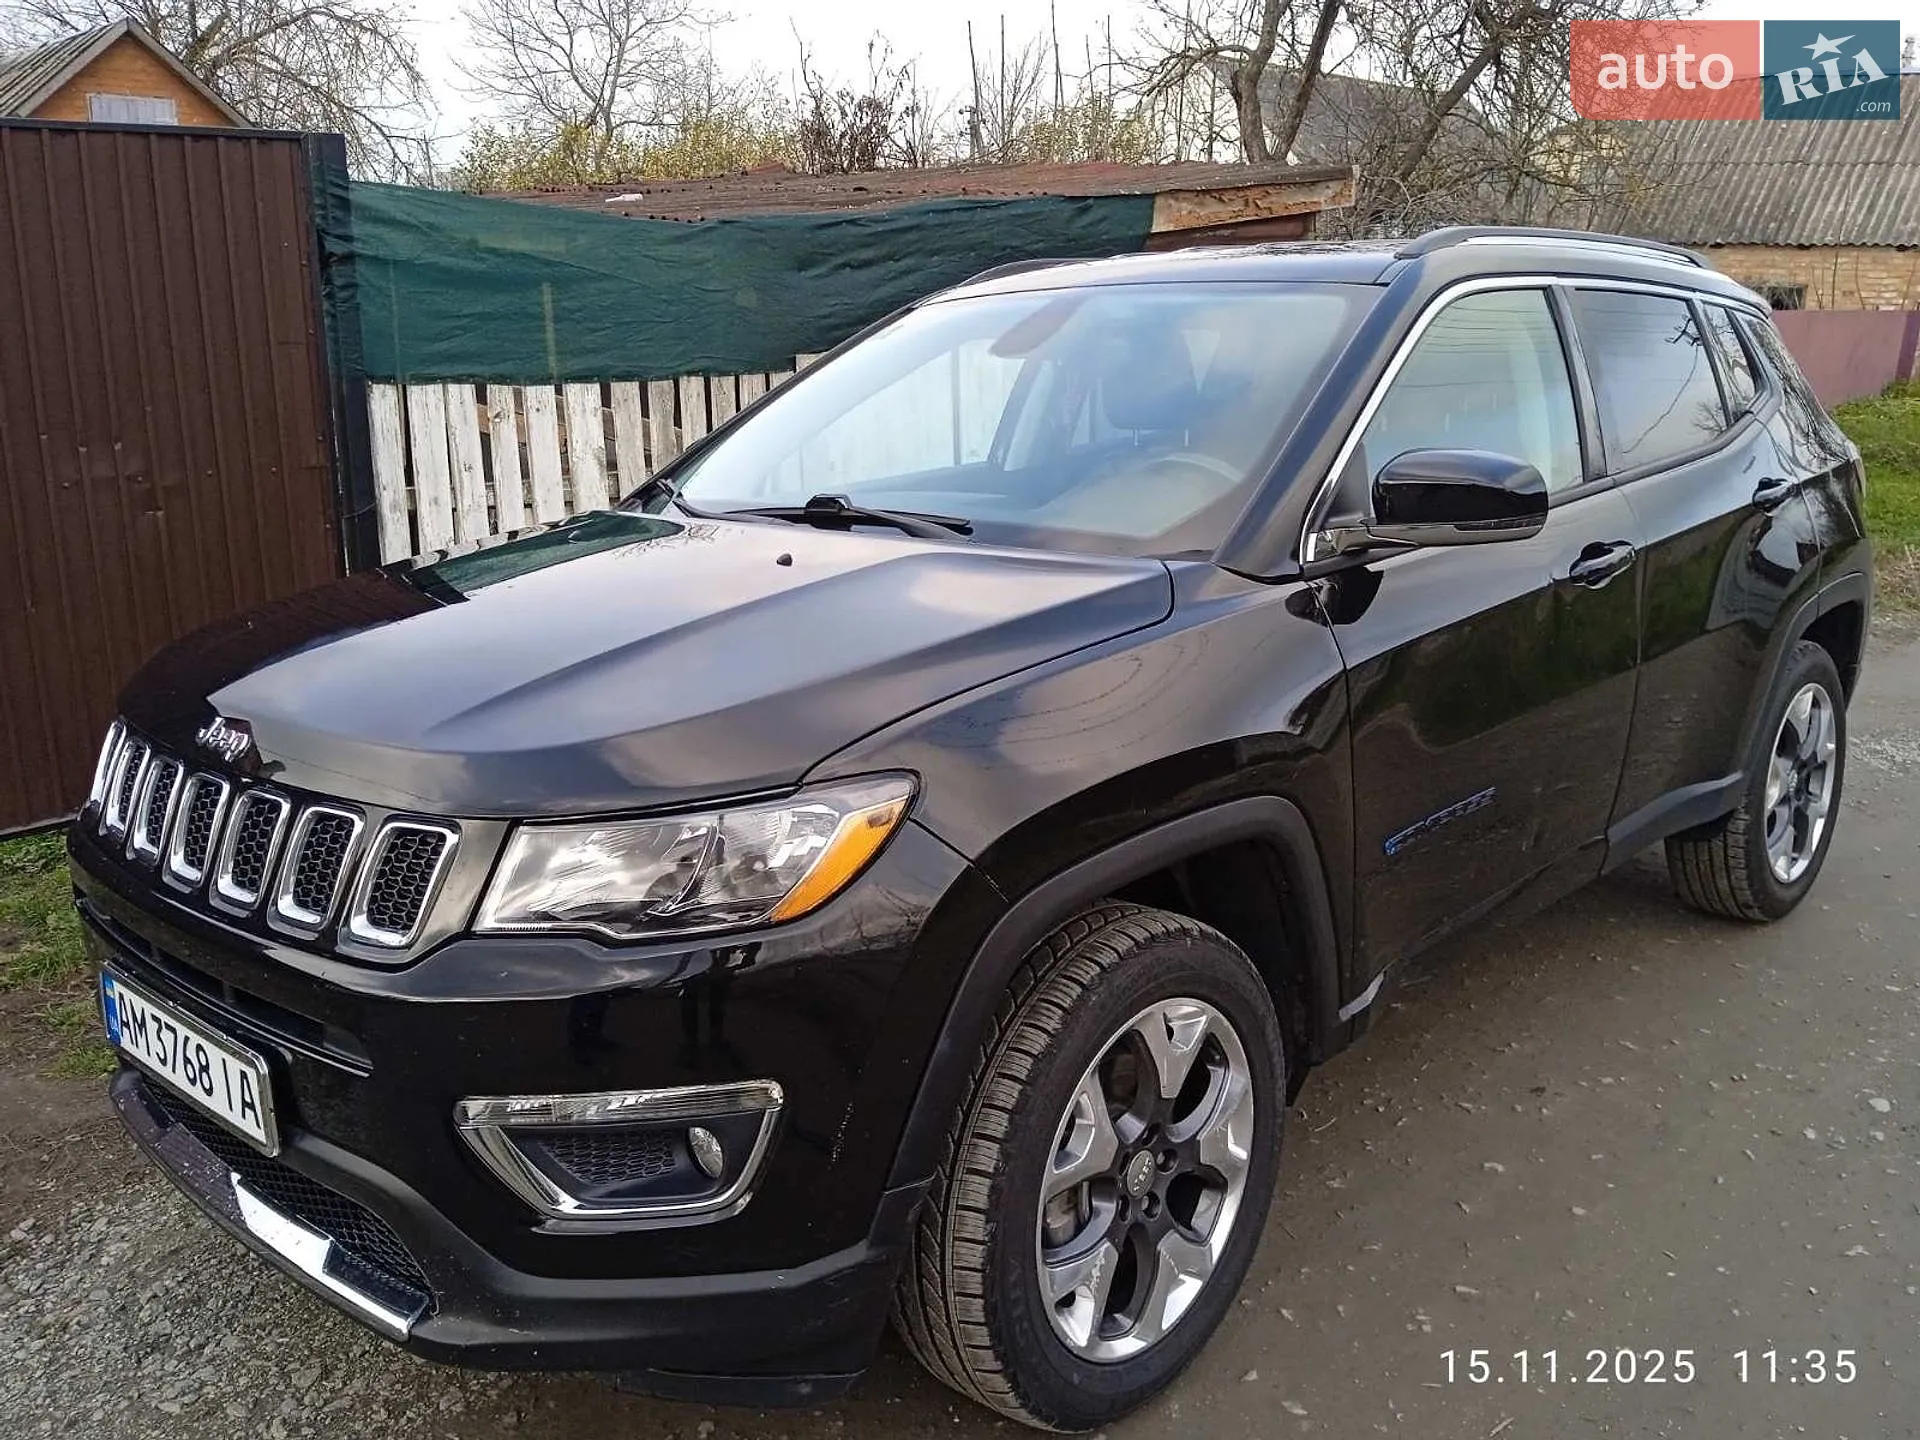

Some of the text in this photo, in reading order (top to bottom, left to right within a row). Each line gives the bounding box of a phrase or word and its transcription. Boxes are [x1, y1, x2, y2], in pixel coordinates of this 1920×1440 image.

[196, 717, 252, 763] Jeep
[118, 991, 262, 1131] AM 3768 IA
